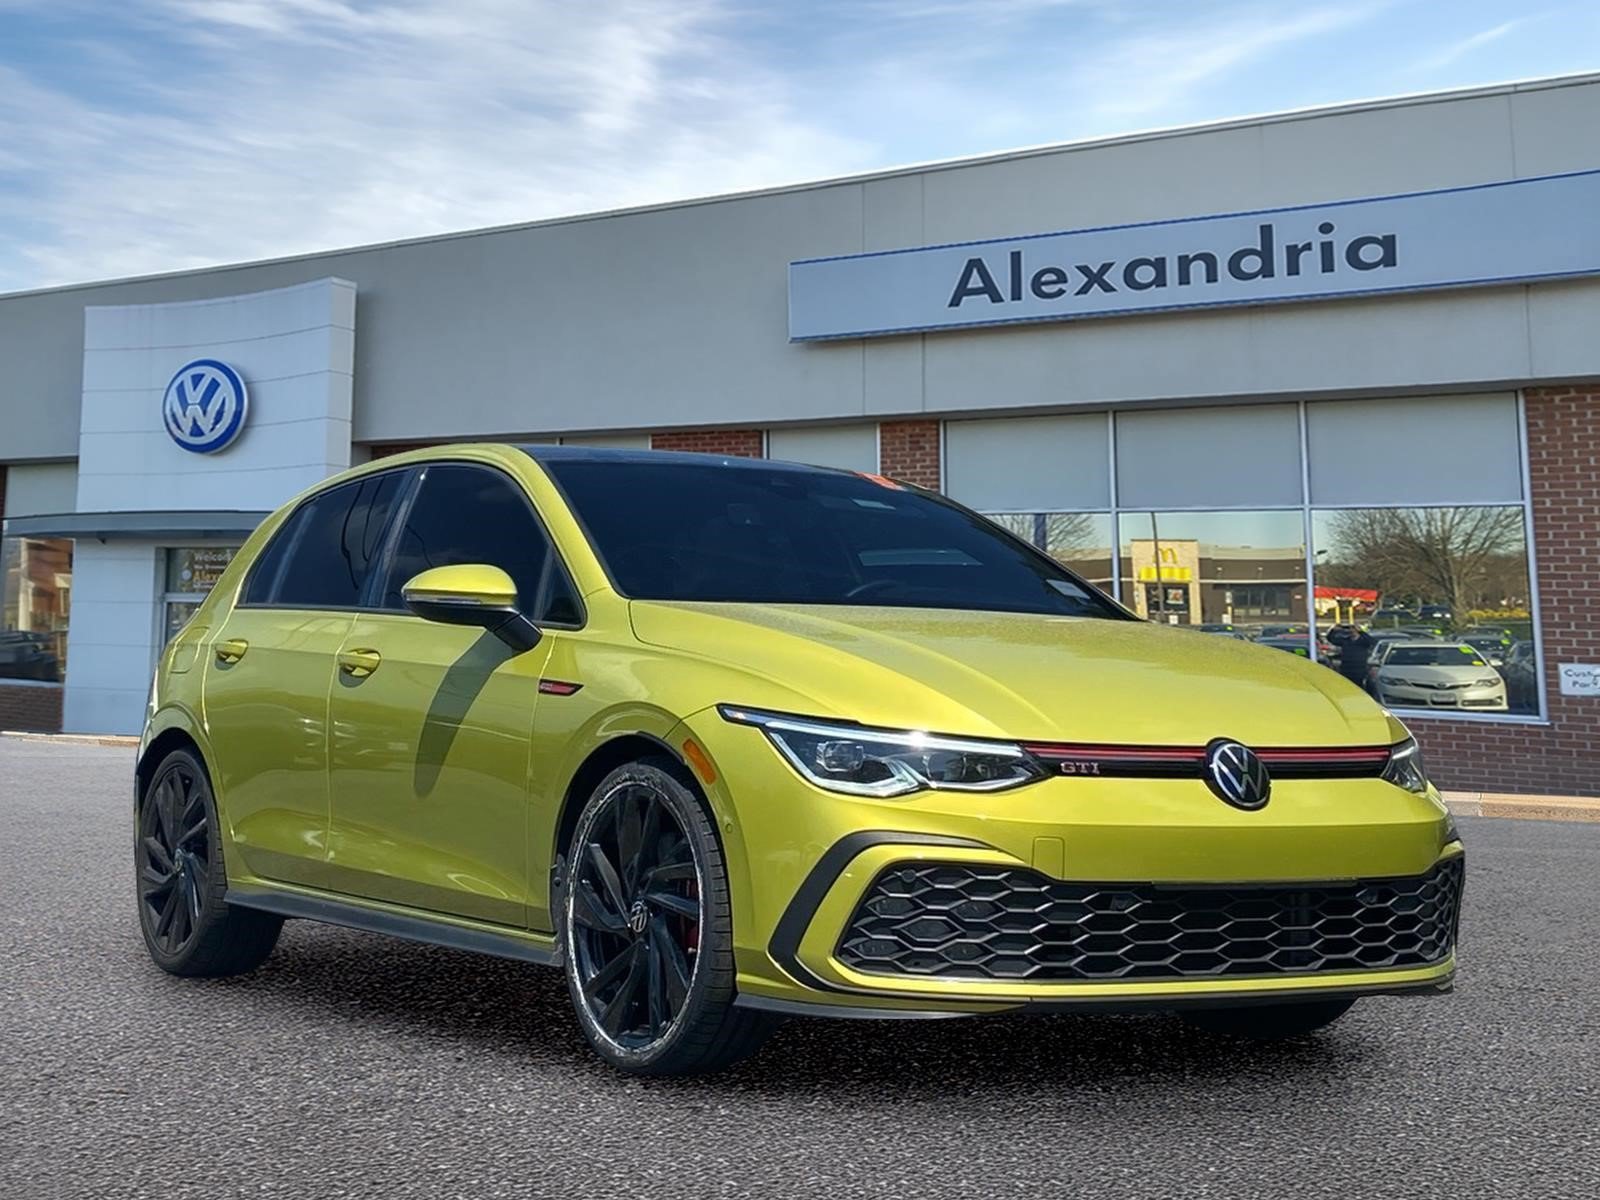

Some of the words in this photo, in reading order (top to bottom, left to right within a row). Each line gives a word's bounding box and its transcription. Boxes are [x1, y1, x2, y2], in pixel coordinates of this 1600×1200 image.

[948, 222, 1397, 308] Alexandria
[165, 365, 237, 445] VW
[1060, 761, 1100, 774] GTI
